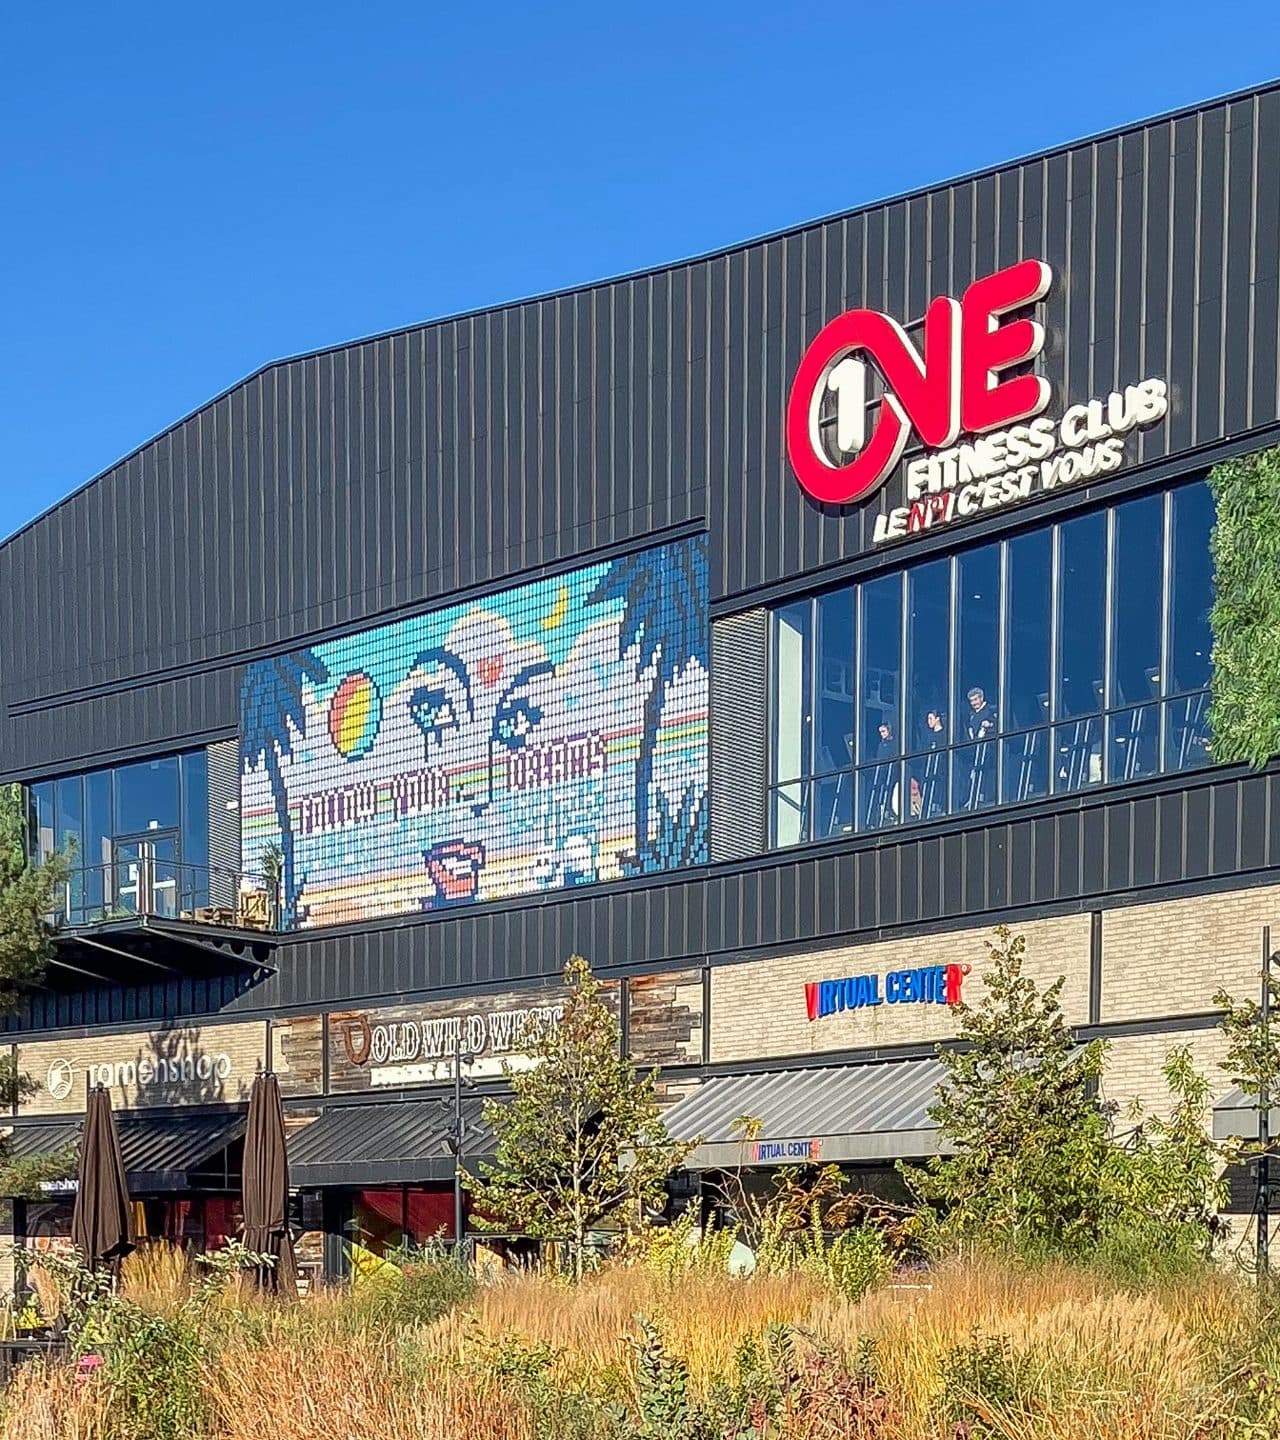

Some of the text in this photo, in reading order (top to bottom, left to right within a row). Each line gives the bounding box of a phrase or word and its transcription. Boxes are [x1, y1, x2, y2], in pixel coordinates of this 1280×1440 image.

[787, 258, 1053, 503] ONE
[907, 377, 1168, 500] FITNESS CLUB
[873, 507, 908, 543] LE
[957, 465, 1040, 517] C'EST
[1040, 438, 1125, 490] VOUS
[805, 974, 885, 1021] VIRTUAL
[371, 1020, 420, 1063] OLD
[421, 1015, 486, 1058] WILD
[88, 1053, 232, 1088] ramenshop
[752, 1142, 786, 1164] VIRTUAL
